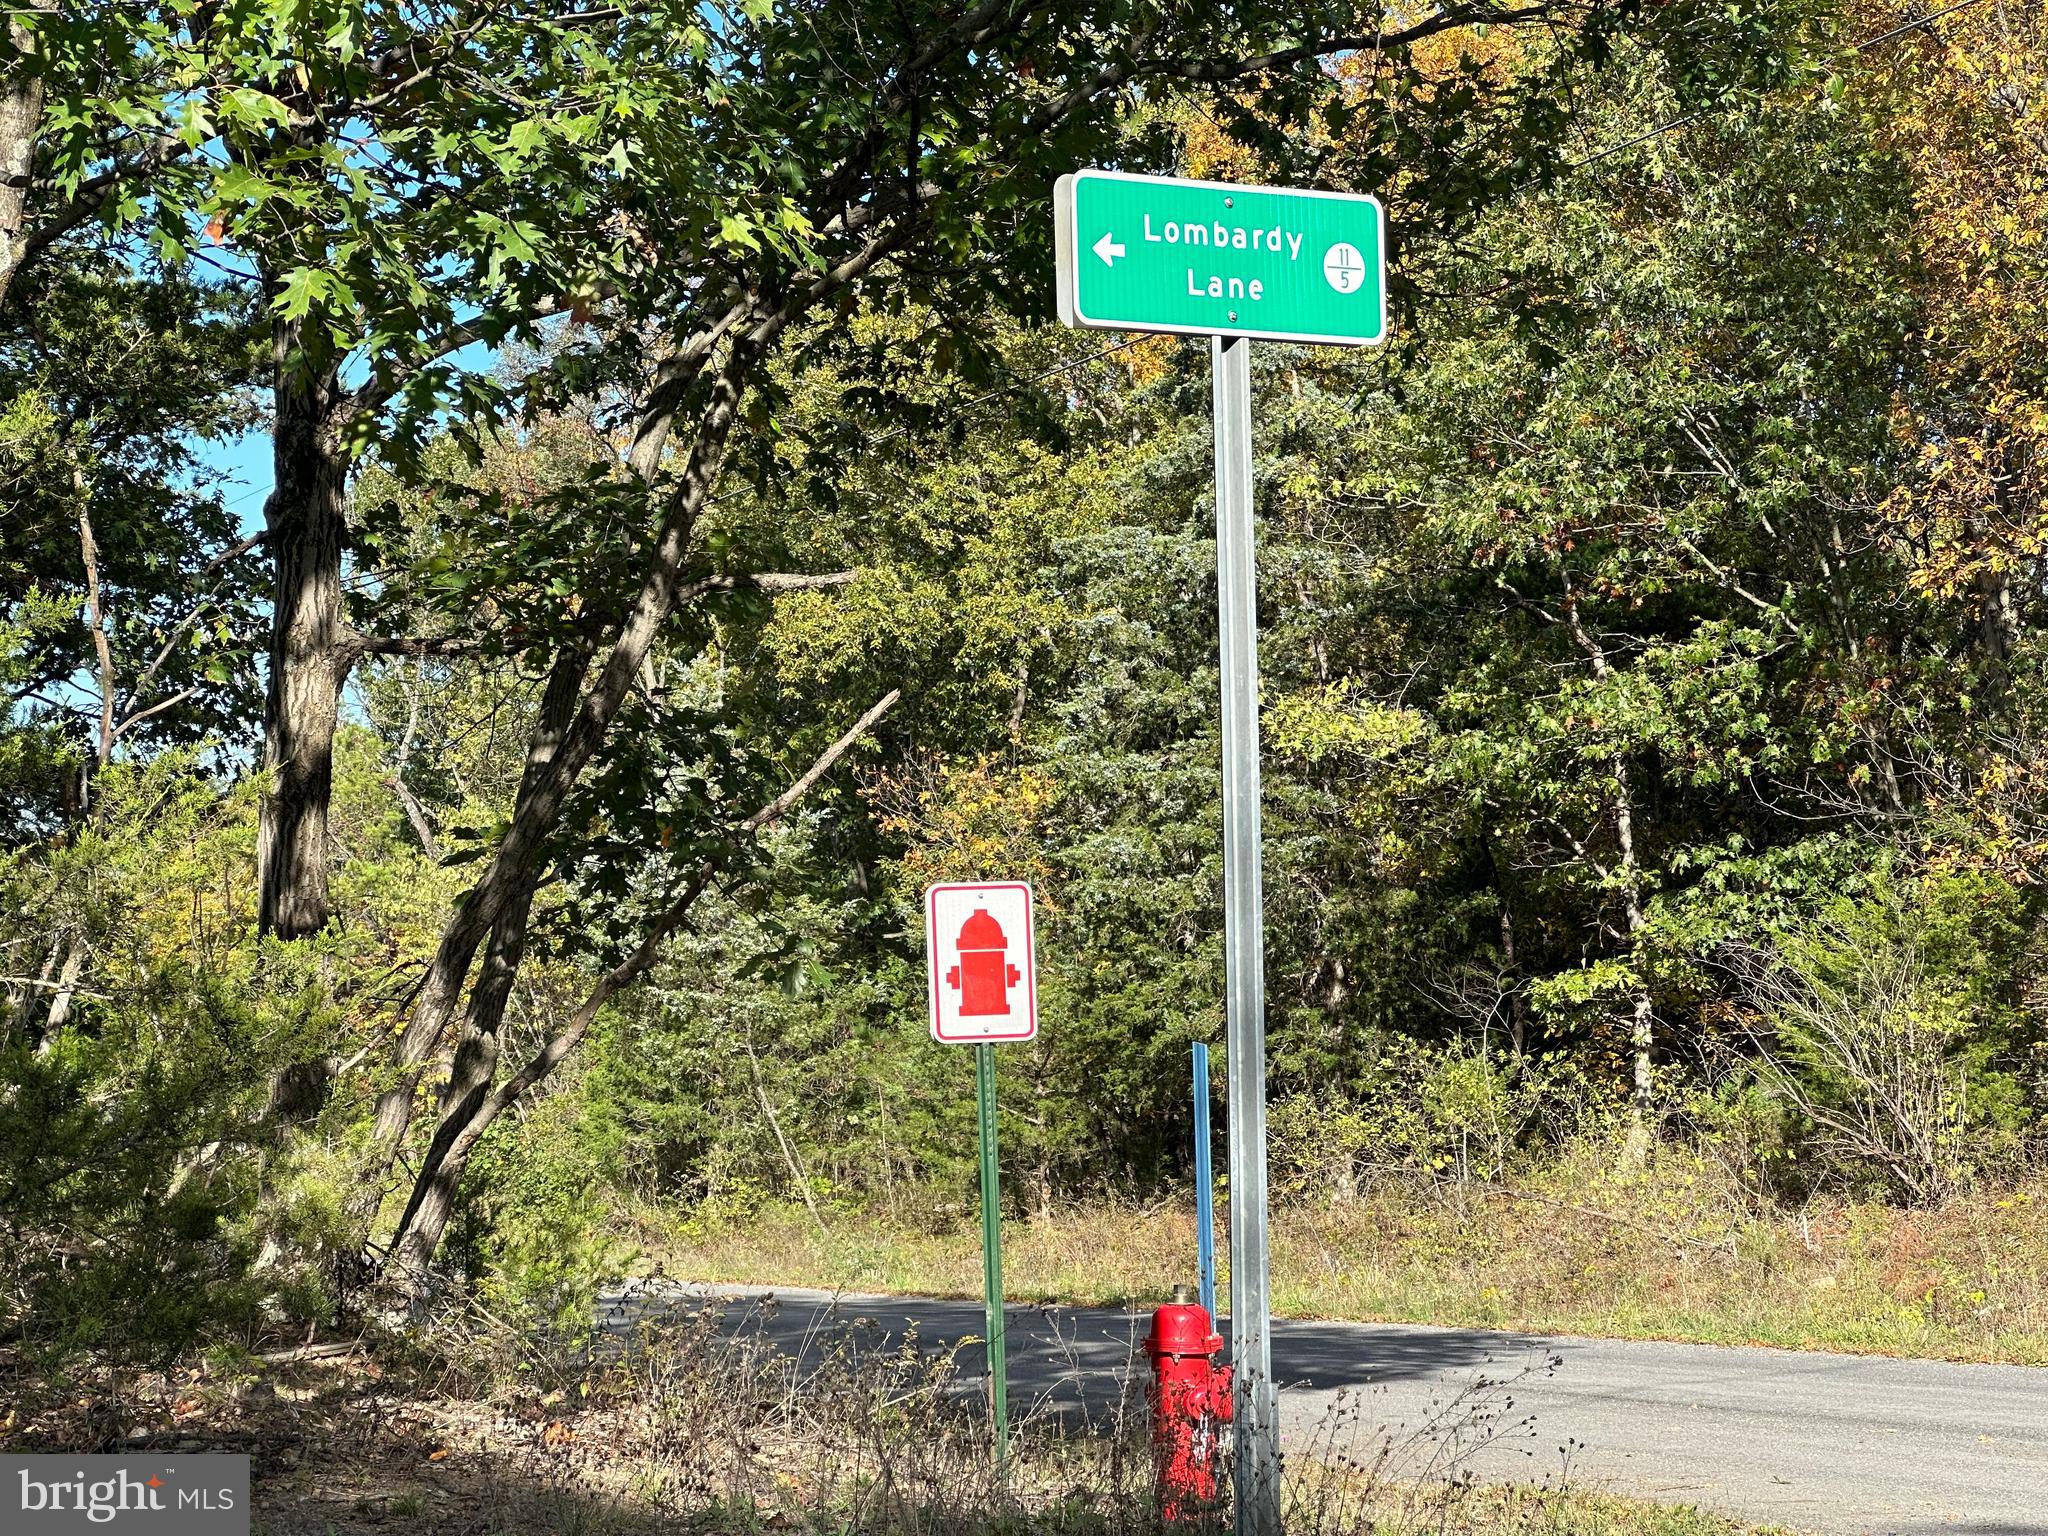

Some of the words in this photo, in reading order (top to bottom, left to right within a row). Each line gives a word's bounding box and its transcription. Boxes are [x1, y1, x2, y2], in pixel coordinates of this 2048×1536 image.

[1143, 213, 1304, 261] Lombardy
[1338, 247, 1349, 266] 11
[1187, 268, 1264, 301] Lane
[1341, 271, 1349, 289] 5
